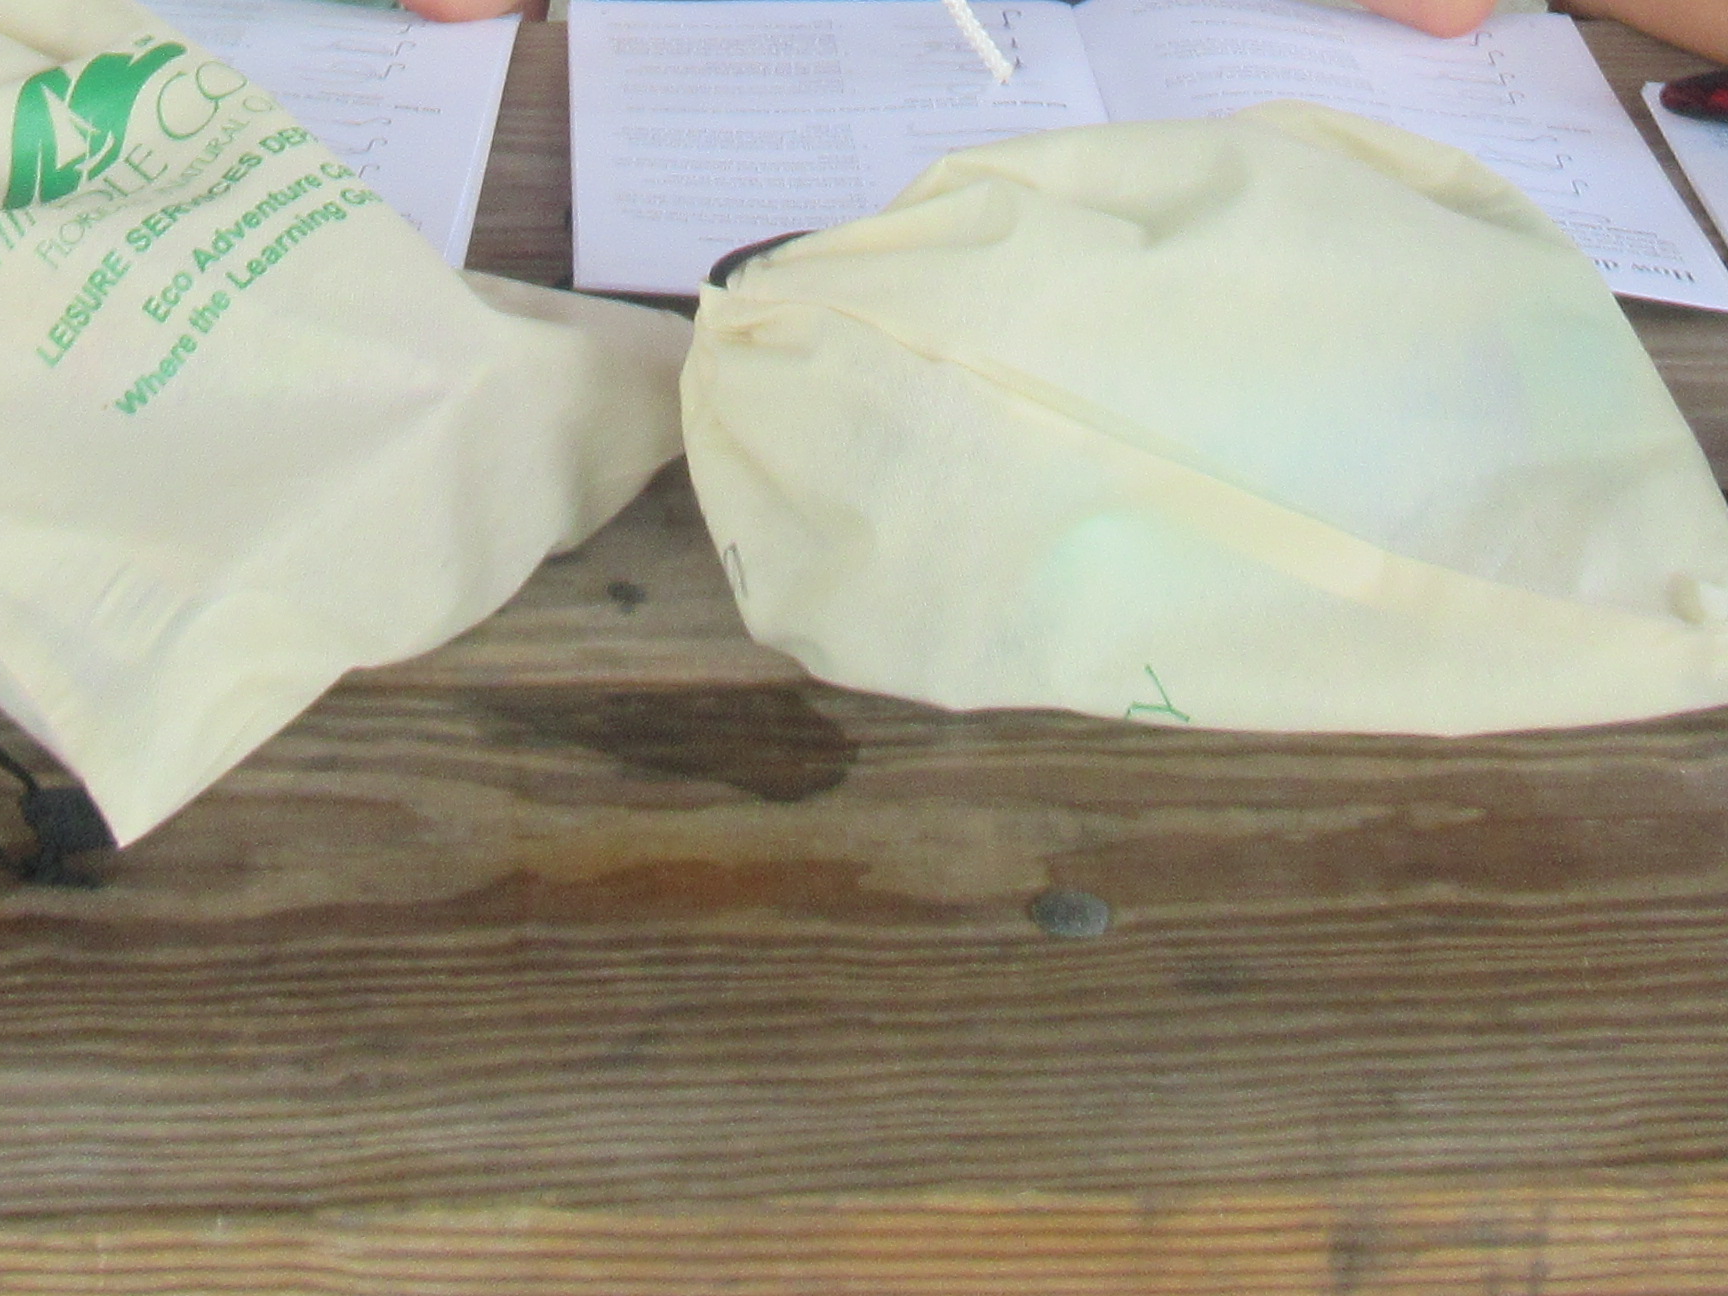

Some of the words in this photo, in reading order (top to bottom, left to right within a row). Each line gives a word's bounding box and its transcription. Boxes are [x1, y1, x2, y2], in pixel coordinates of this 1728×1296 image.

[36, 249, 134, 368] LEISURE
[125, 151, 264, 254] SERCES
[114, 334, 199, 415] Where
[188, 290, 231, 334] the
[225, 200, 348, 290] Learning
[141, 271, 194, 324] Eco
[192, 174, 323, 274] Adventure
